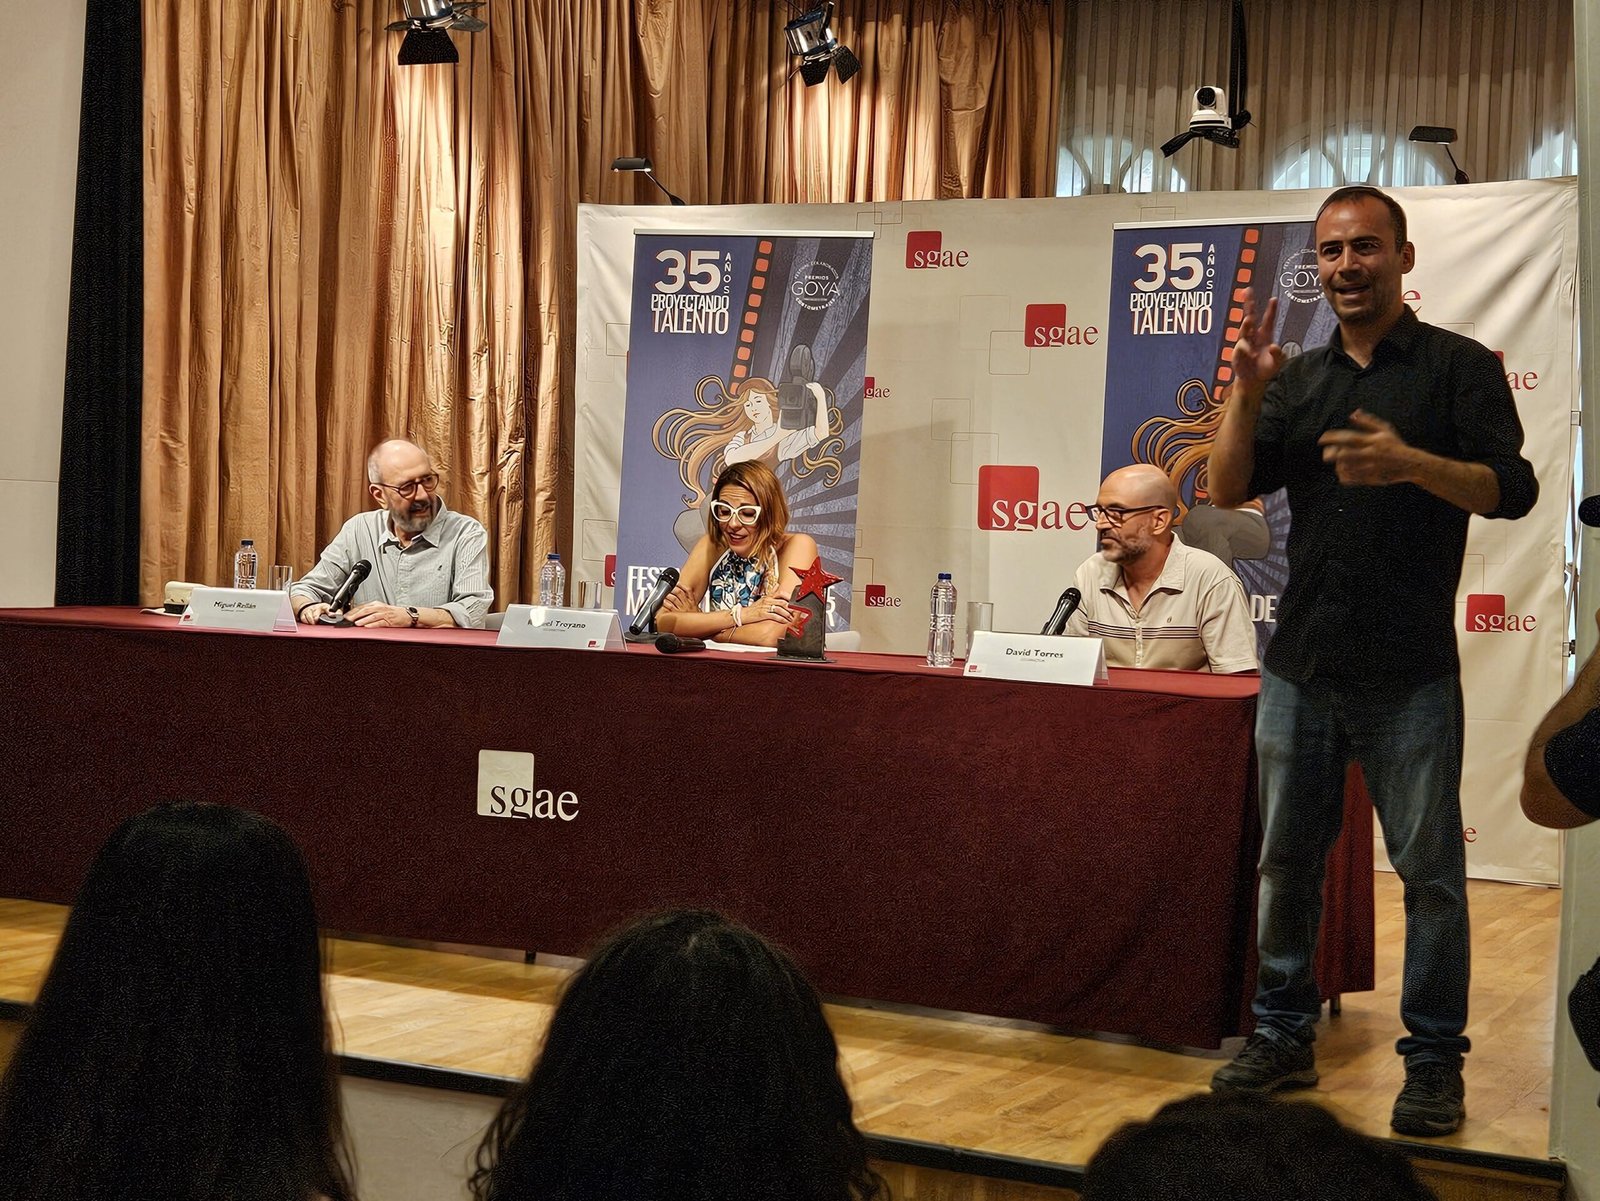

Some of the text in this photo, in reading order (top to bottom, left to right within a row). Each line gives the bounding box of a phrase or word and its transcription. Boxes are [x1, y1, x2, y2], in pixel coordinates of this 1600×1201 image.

[913, 249, 969, 269] sgae
[1132, 242, 1204, 292] 35
[653, 249, 721, 294] 35
[1279, 270, 1322, 288] GOY
[791, 280, 840, 296] GOYA
[651, 293, 730, 311] PROYECTANDO
[1130, 291, 1213, 310] PROYECTANDO
[652, 307, 729, 335] TALENTO
[1130, 307, 1212, 335] TALENTO
[1033, 326, 1099, 347] sgae
[864, 387, 891, 399] gae
[991, 499, 1089, 532] sgae
[869, 595, 901, 607] sgae
[1250, 594, 1277, 622] DE
[555, 620, 586, 629] Troyano
[1474, 613, 1537, 633] sgae
[1005, 648, 1064, 659] David Torres
[490, 786, 579, 821] sgae
